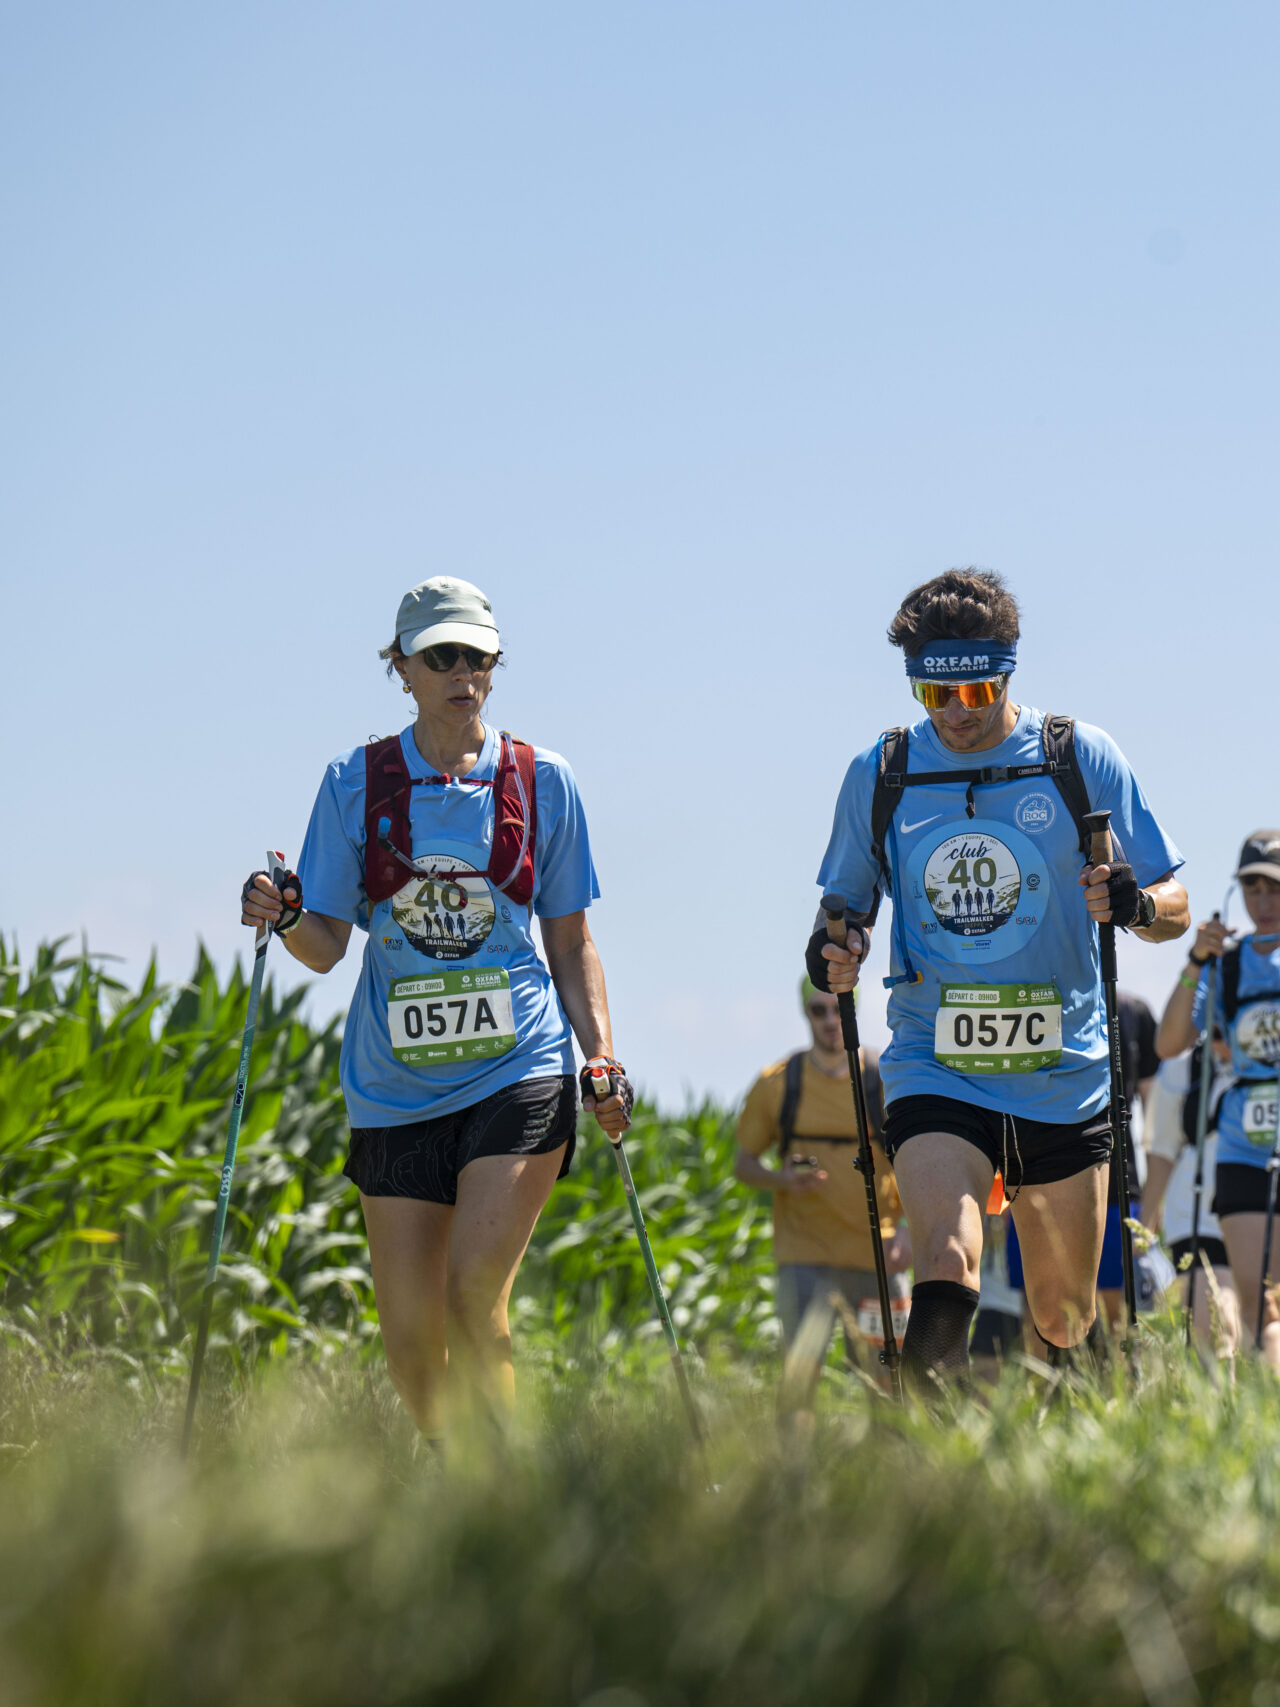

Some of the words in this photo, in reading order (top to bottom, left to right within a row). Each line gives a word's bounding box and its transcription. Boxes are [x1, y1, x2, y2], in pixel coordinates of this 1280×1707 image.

[924, 655, 989, 667] OXFAM
[926, 664, 989, 673] TRAILWALKER
[1024, 812, 1046, 821] ROC
[943, 841, 992, 863] club
[947, 857, 997, 889] 40
[414, 881, 468, 913] 40
[953, 916, 994, 924] TRAILWALKER
[1016, 916, 1037, 926] ISARA
[425, 938, 468, 948] TRAILWALKER
[487, 944, 509, 954] ISARA
[947, 992, 968, 1001] DÉPART
[969, 993, 974, 1001] C
[404, 997, 498, 1039] 057A
[954, 1012, 1046, 1047] 057C
